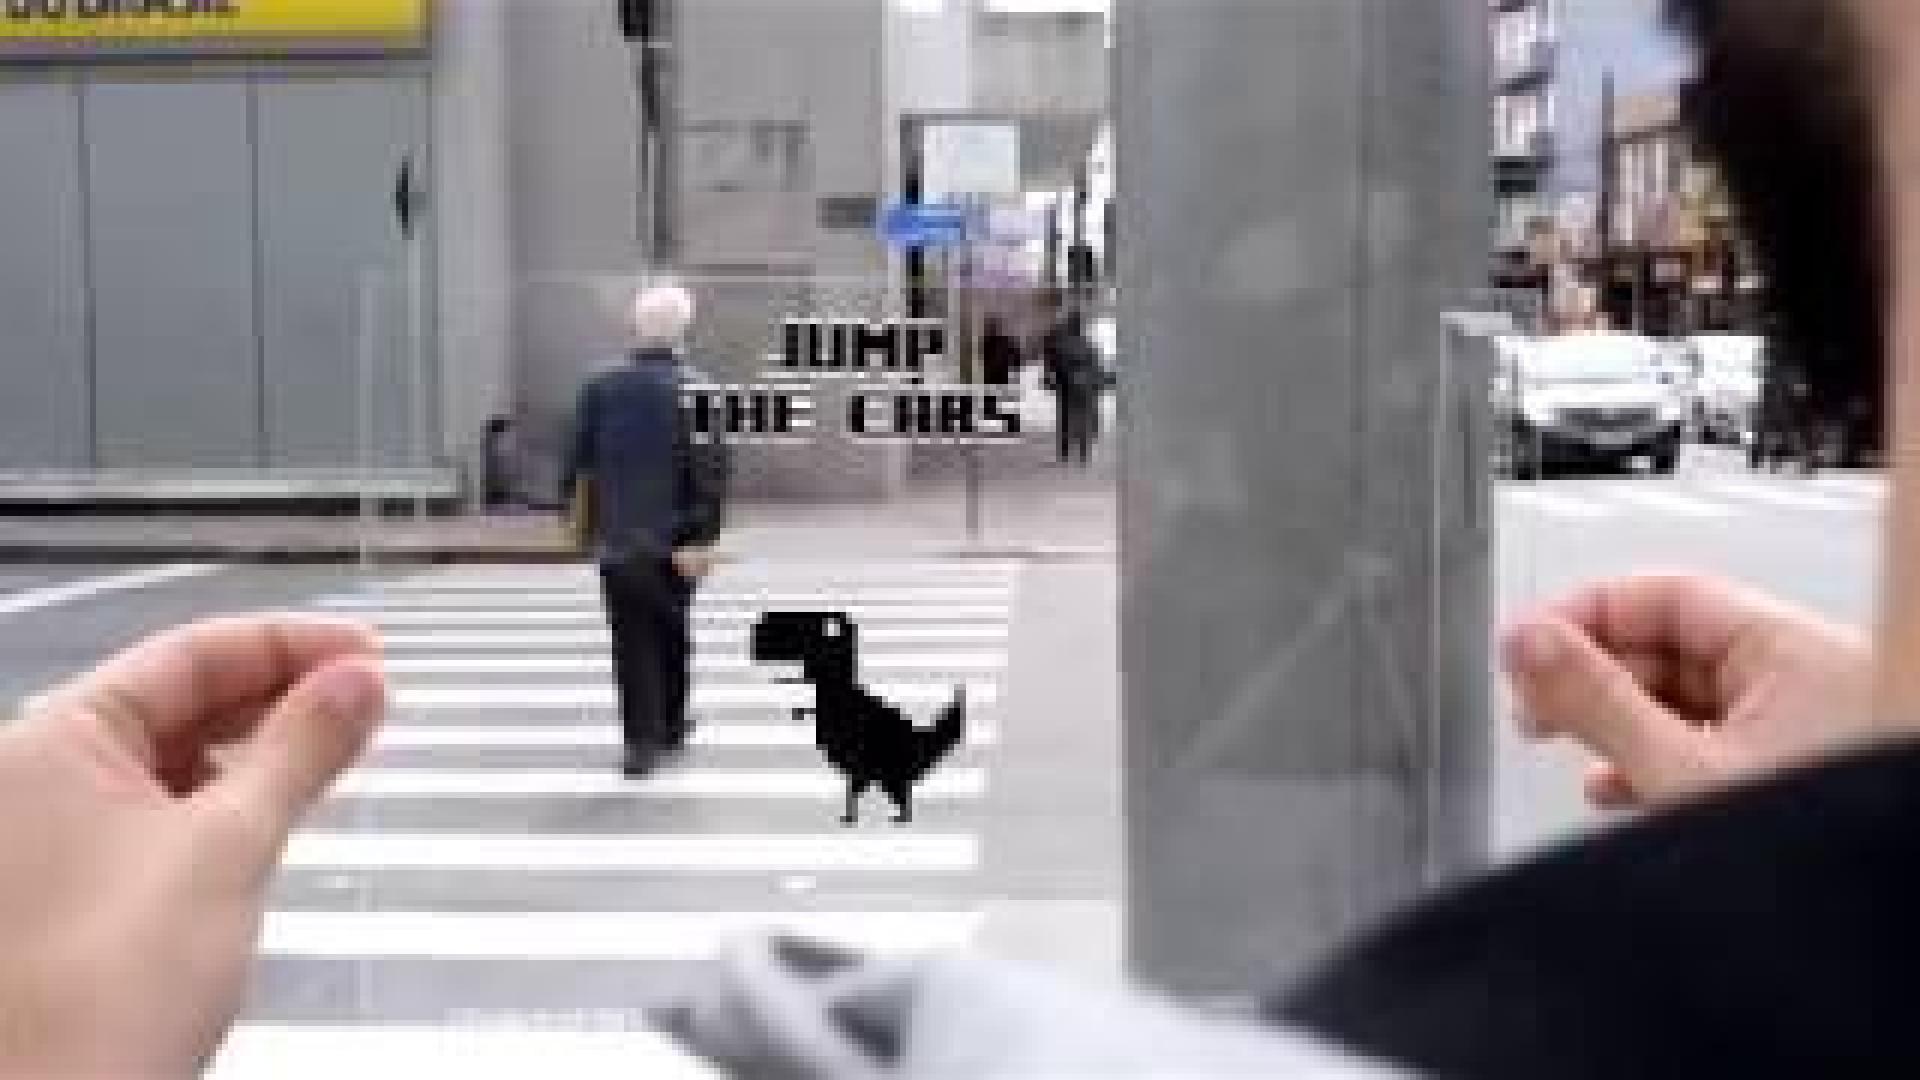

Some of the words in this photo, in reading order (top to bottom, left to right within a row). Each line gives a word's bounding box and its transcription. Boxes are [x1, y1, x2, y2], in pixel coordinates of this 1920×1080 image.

[766, 322, 945, 369] JUMP
[681, 389, 813, 436] THE
[848, 389, 1022, 436] CARS
